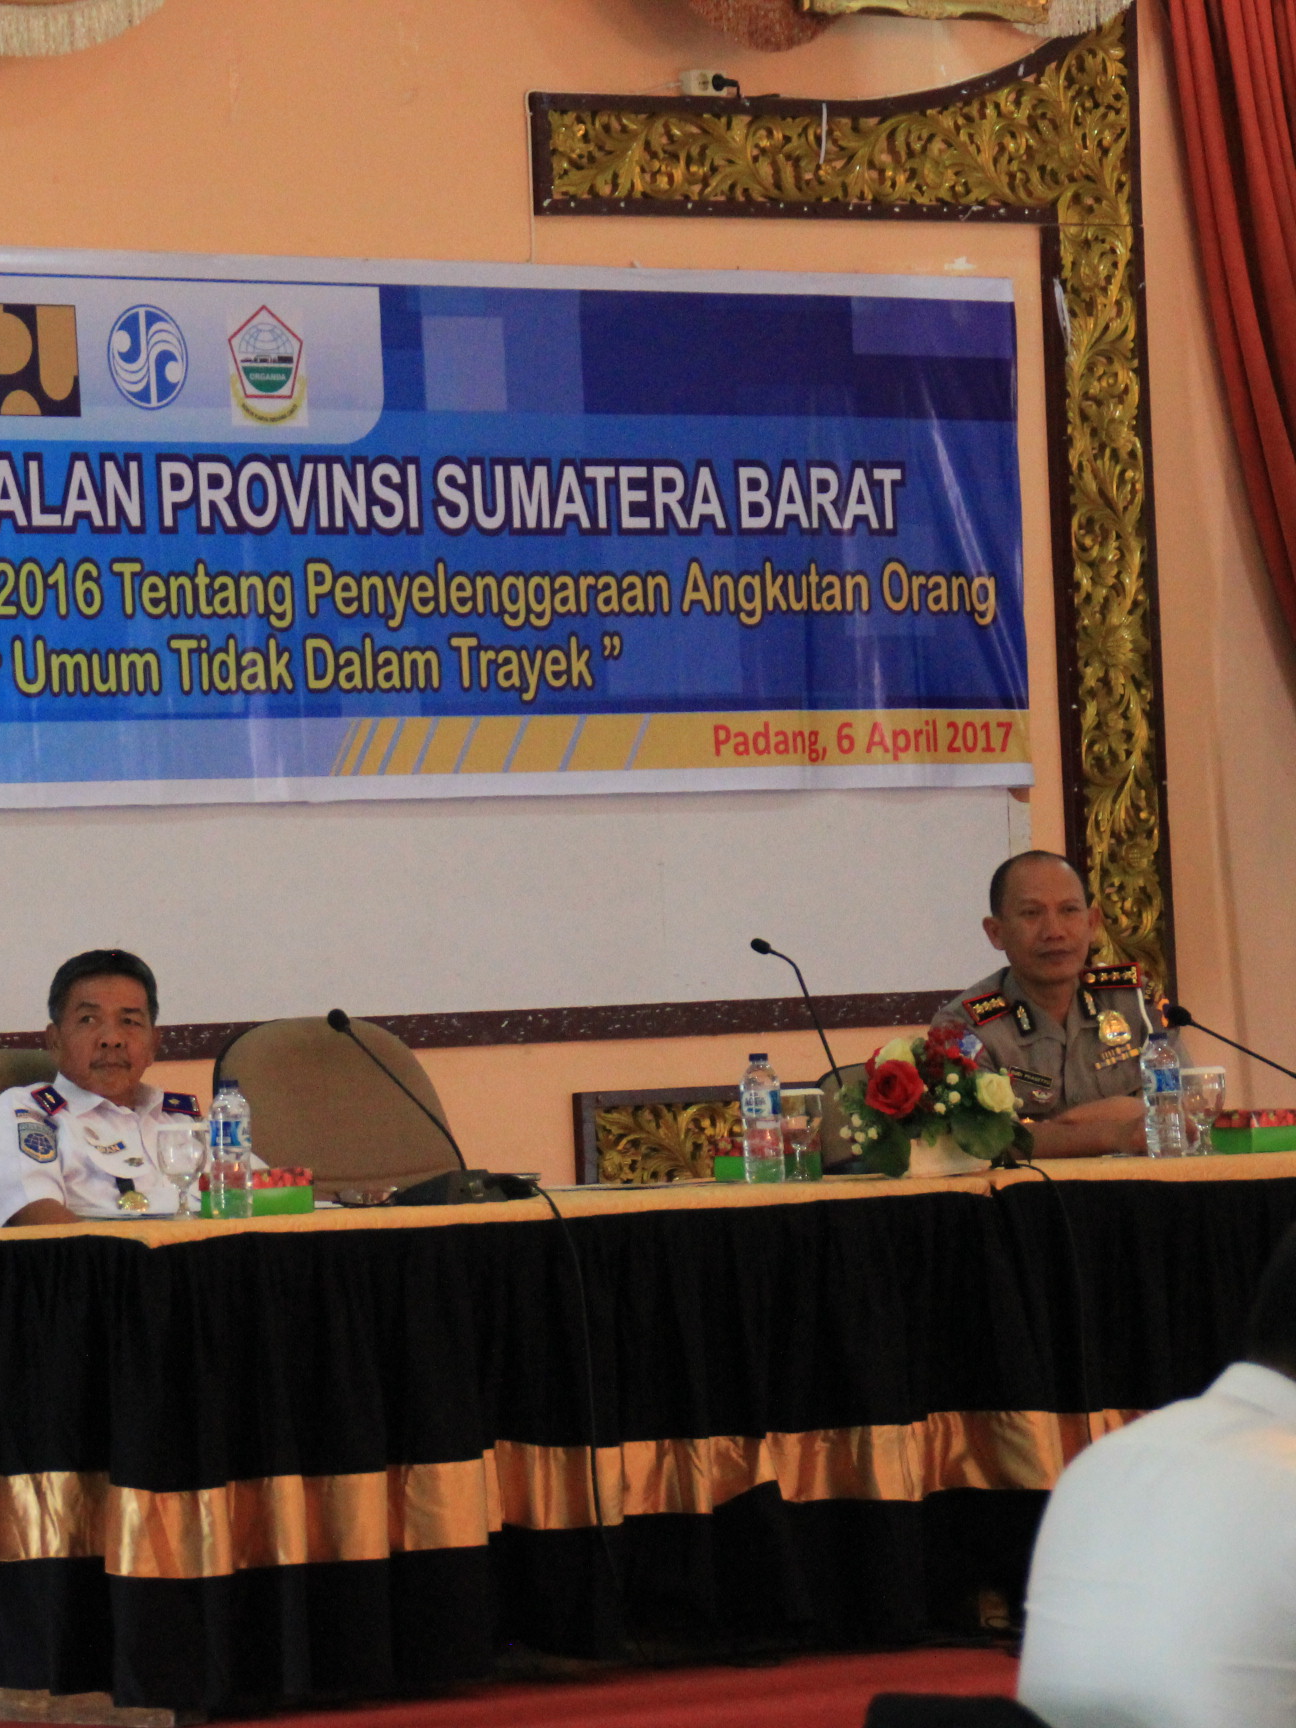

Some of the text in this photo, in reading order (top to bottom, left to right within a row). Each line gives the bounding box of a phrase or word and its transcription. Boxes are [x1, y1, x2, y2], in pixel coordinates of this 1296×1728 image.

[160, 460, 421, 530] PROVINSI
[435, 462, 727, 531] SUMATERA
[737, 465, 903, 531] BARAT
[111, 561, 294, 629] Tentang
[306, 560, 671, 628] Penyelenggaraan
[681, 560, 870, 627] Angkutan
[881, 560, 998, 627] Orang
[12, 638, 161, 695] Umum
[169, 637, 294, 693] Tidak
[304, 636, 442, 691] Dalam
[449, 634, 595, 703] Trayek
[713, 718, 1014, 764] Padang, 6 April 2017
